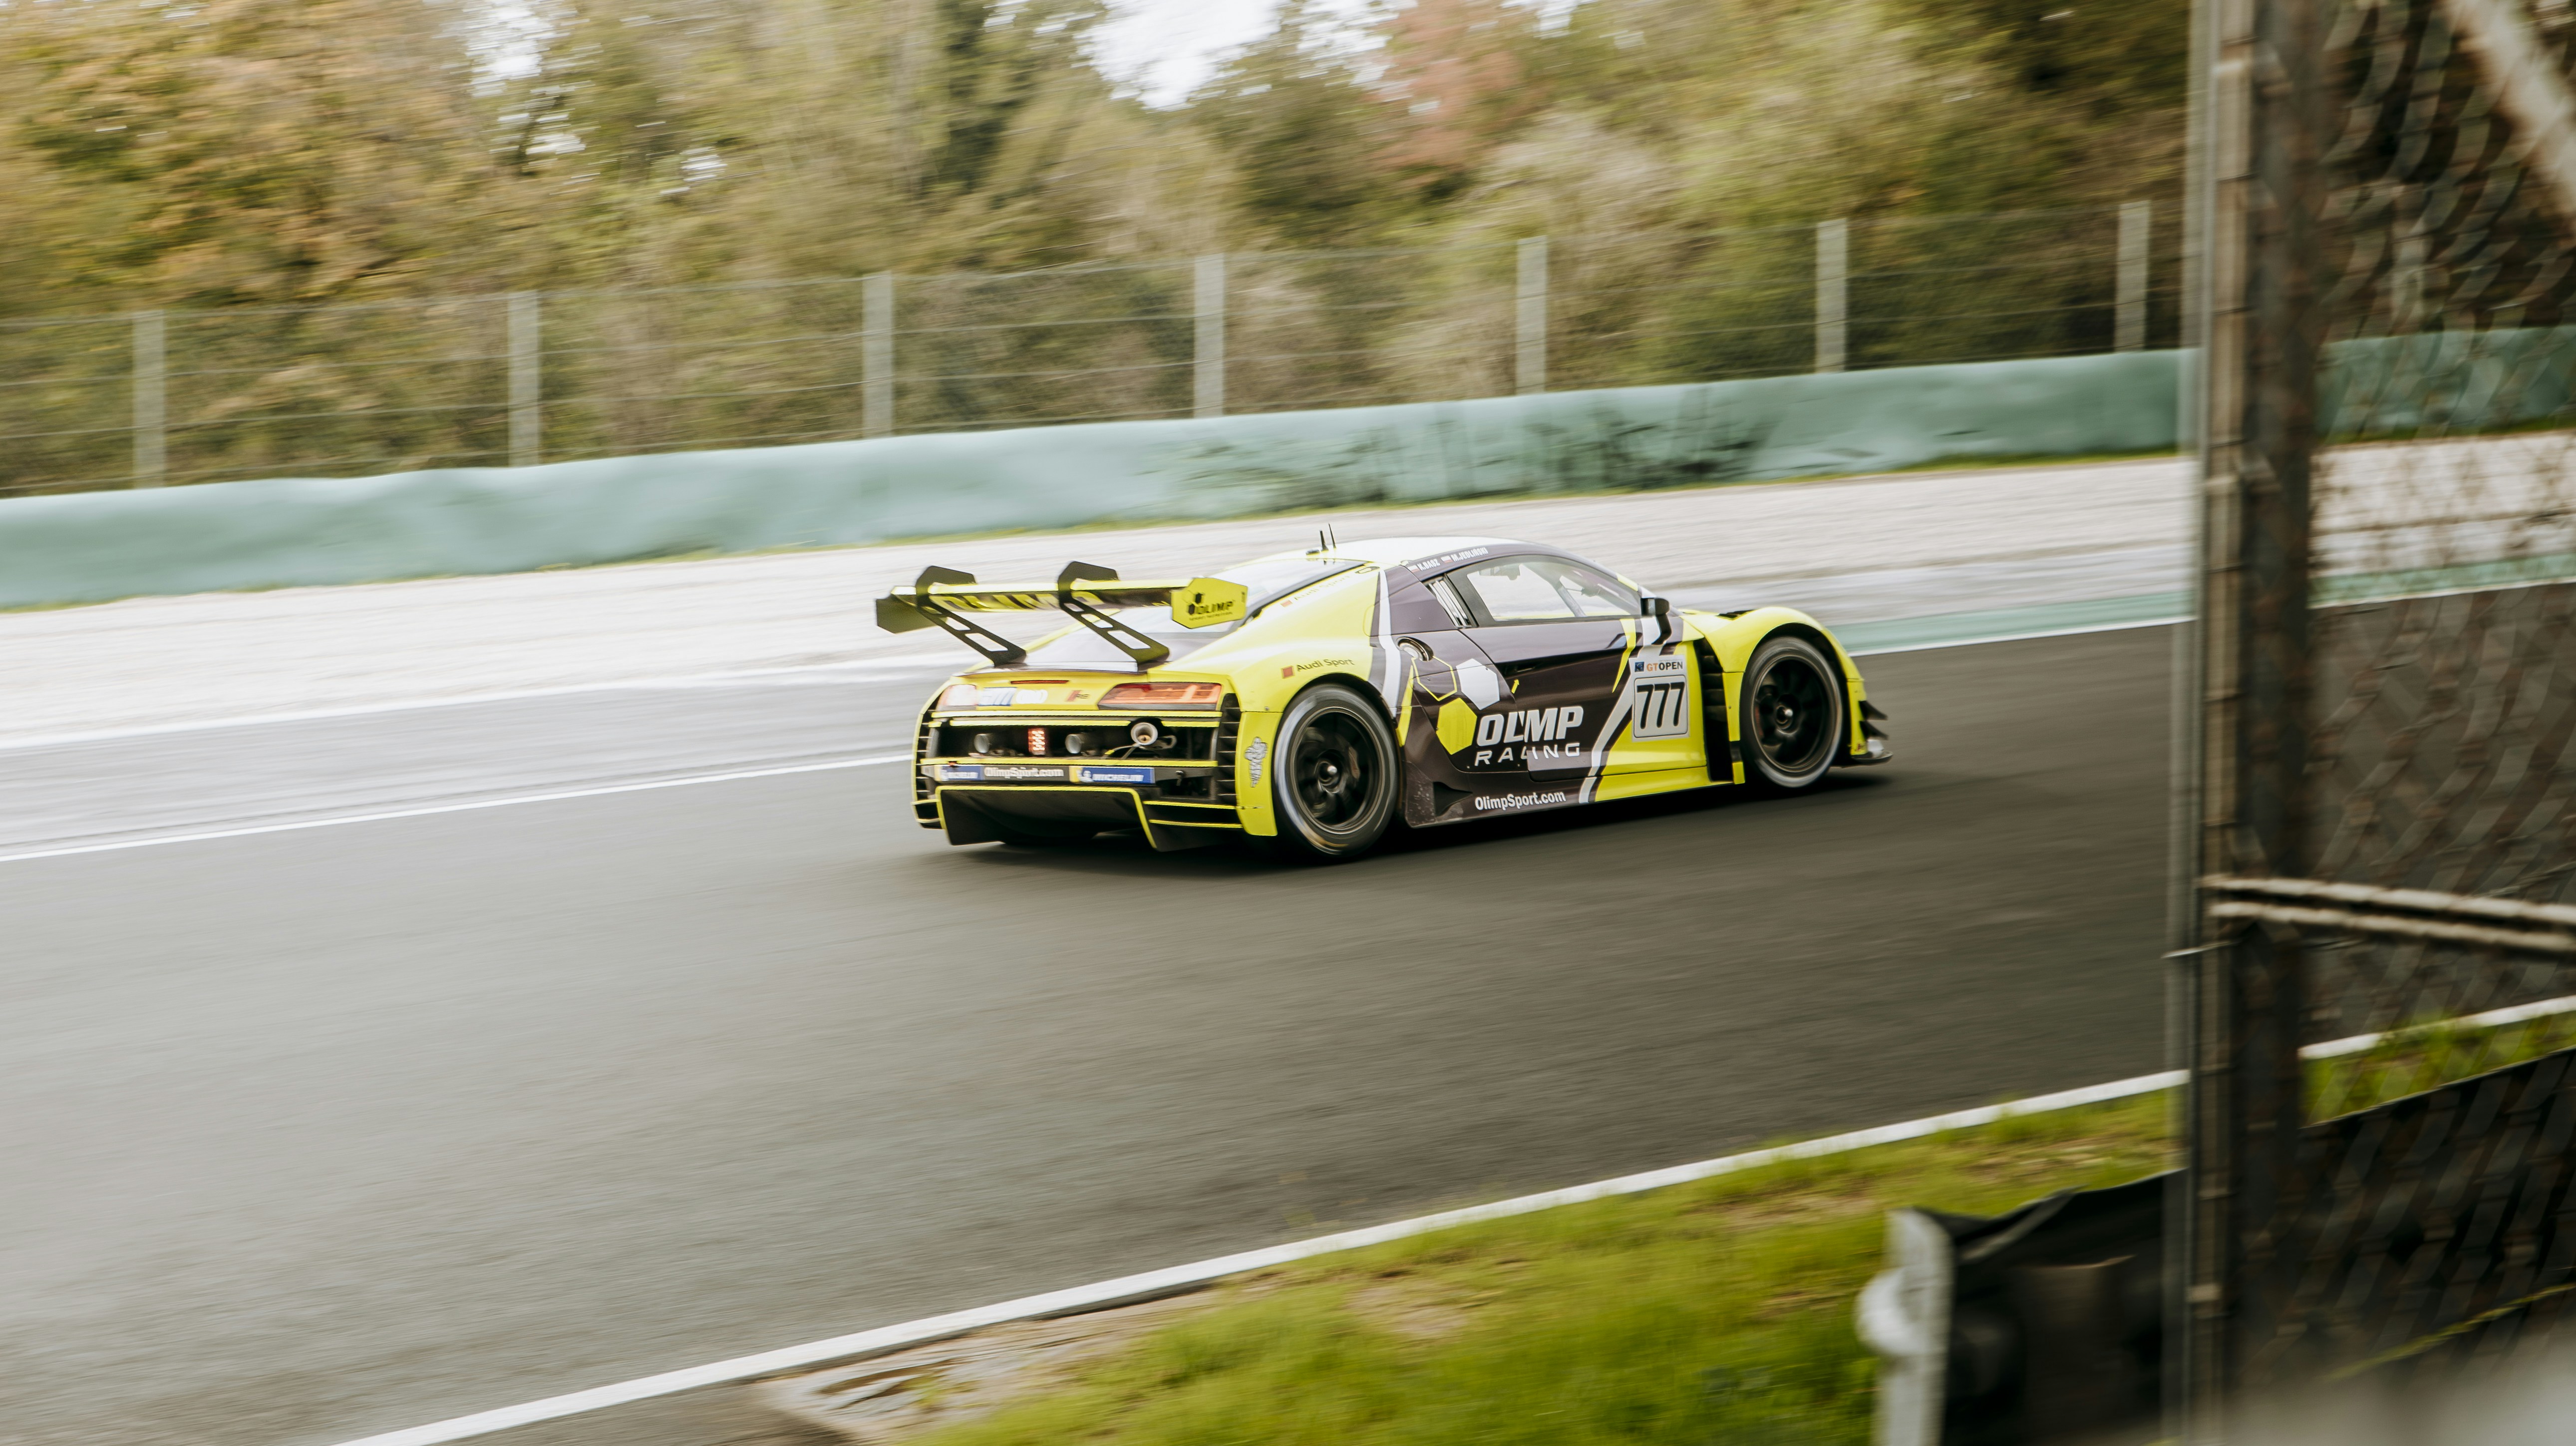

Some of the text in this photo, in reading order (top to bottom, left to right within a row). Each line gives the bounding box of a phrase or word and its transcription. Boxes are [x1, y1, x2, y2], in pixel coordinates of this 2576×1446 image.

[1297, 660, 1323, 672] Audi
[1637, 682, 1685, 729] 777
[984, 767, 1064, 779] OlimpSport.com
[1475, 792, 1567, 811] OlimpSport.com
